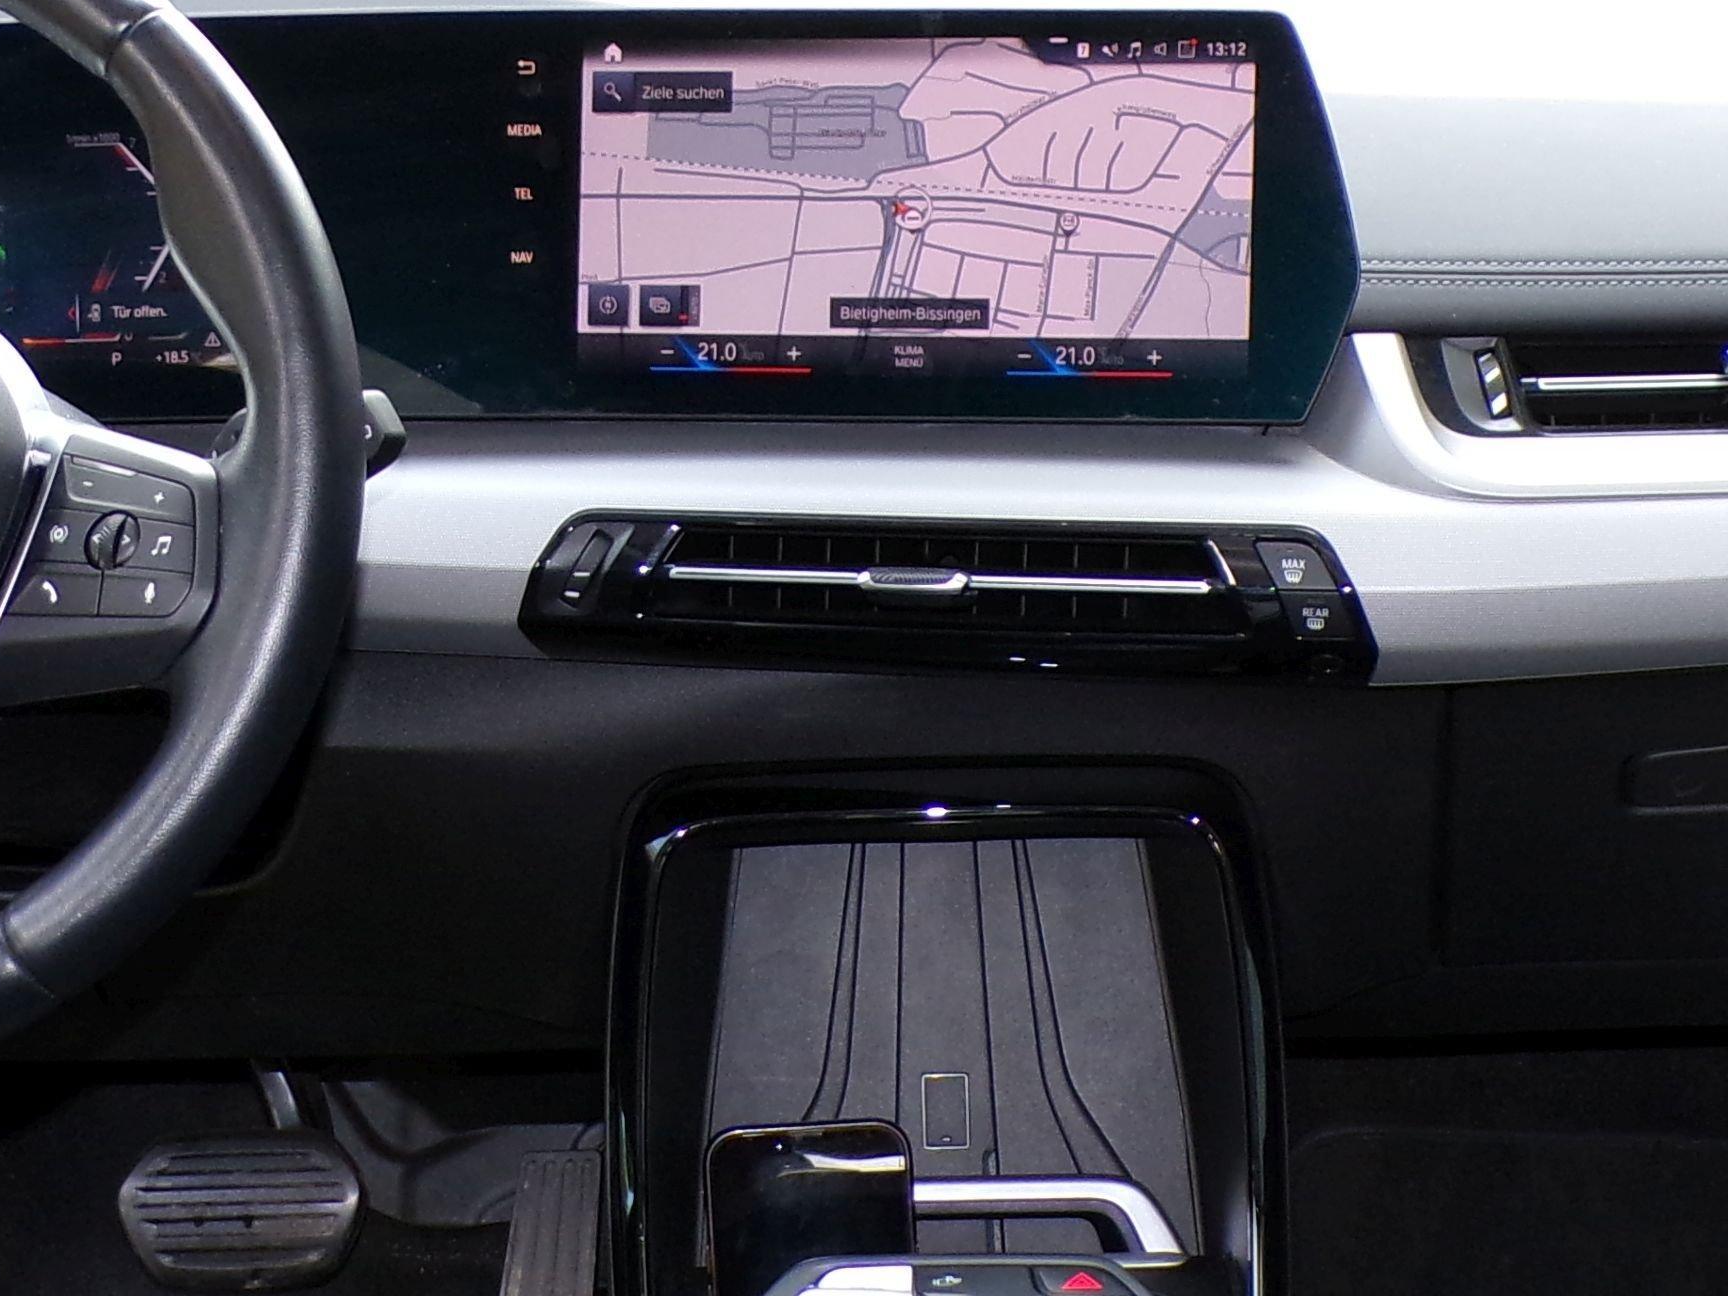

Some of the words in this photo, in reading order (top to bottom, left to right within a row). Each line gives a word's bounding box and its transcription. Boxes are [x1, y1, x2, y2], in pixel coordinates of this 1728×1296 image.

[1207, 41, 1247, 57] 13:12
[641, 85, 674, 101] Ziele
[677, 85, 725, 100] suchen
[506, 124, 542, 137] MEDIA
[514, 186, 534, 201] TEL
[510, 250, 534, 264] NAV
[111, 304, 130, 319] Tür
[839, 305, 982, 323] Bietigheim-Bissingen
[697, 341, 738, 362] 21.0
[894, 345, 925, 356] KLIMA
[1055, 345, 1096, 366] 21.0
[111, 351, 123, 367] P
[1281, 558, 1306, 570] MAX
[1302, 607, 1330, 618] REAR
